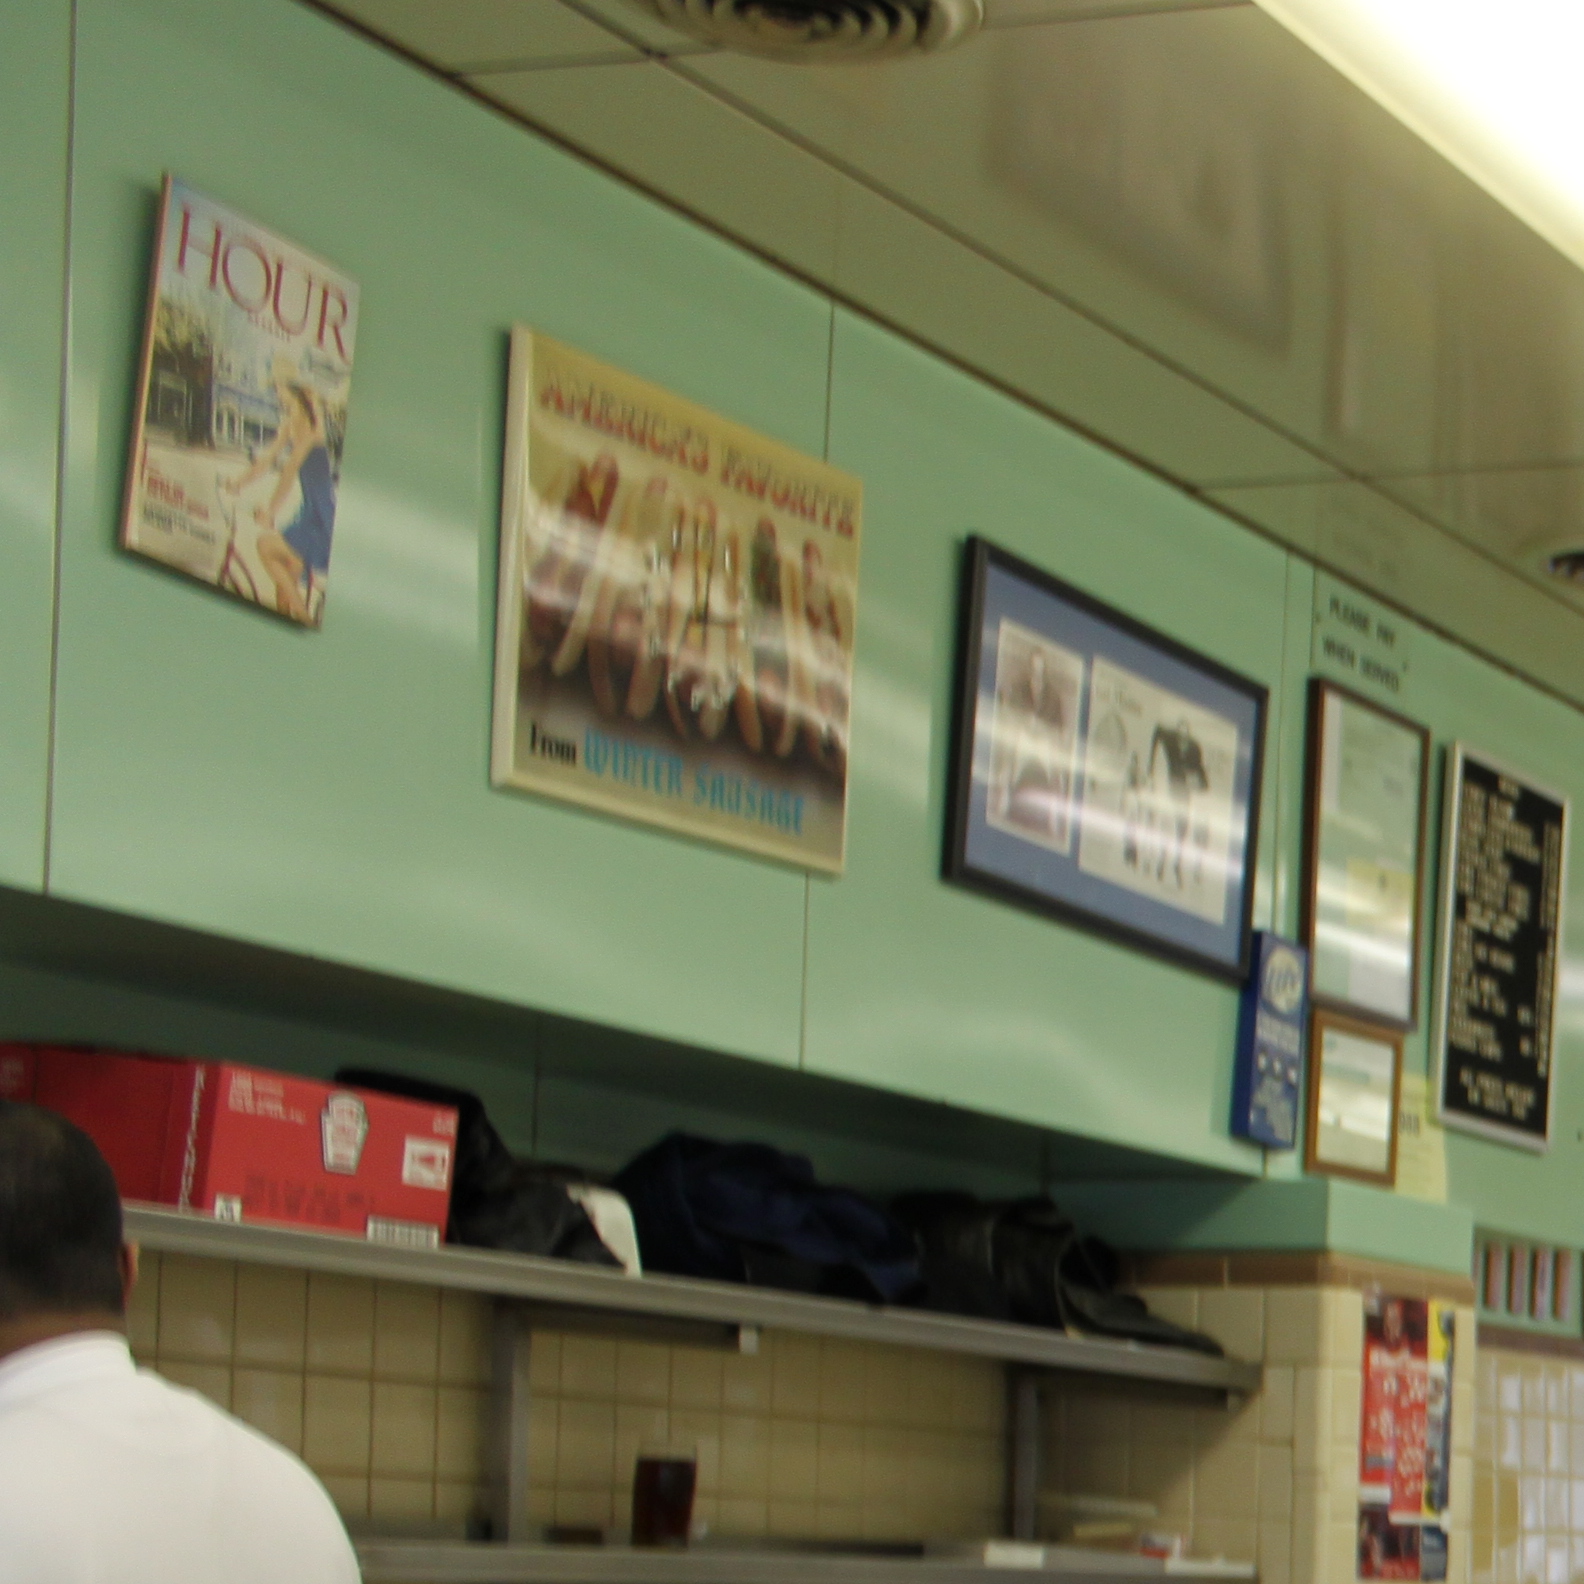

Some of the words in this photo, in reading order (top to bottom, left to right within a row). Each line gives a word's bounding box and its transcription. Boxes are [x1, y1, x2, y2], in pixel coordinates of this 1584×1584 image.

[174, 201, 352, 366] HOUR
[720, 438, 854, 539] FAVORITE
[529, 718, 577, 767] From
[584, 723, 684, 798] WINTER
[693, 760, 804, 837] SAUSAGE
